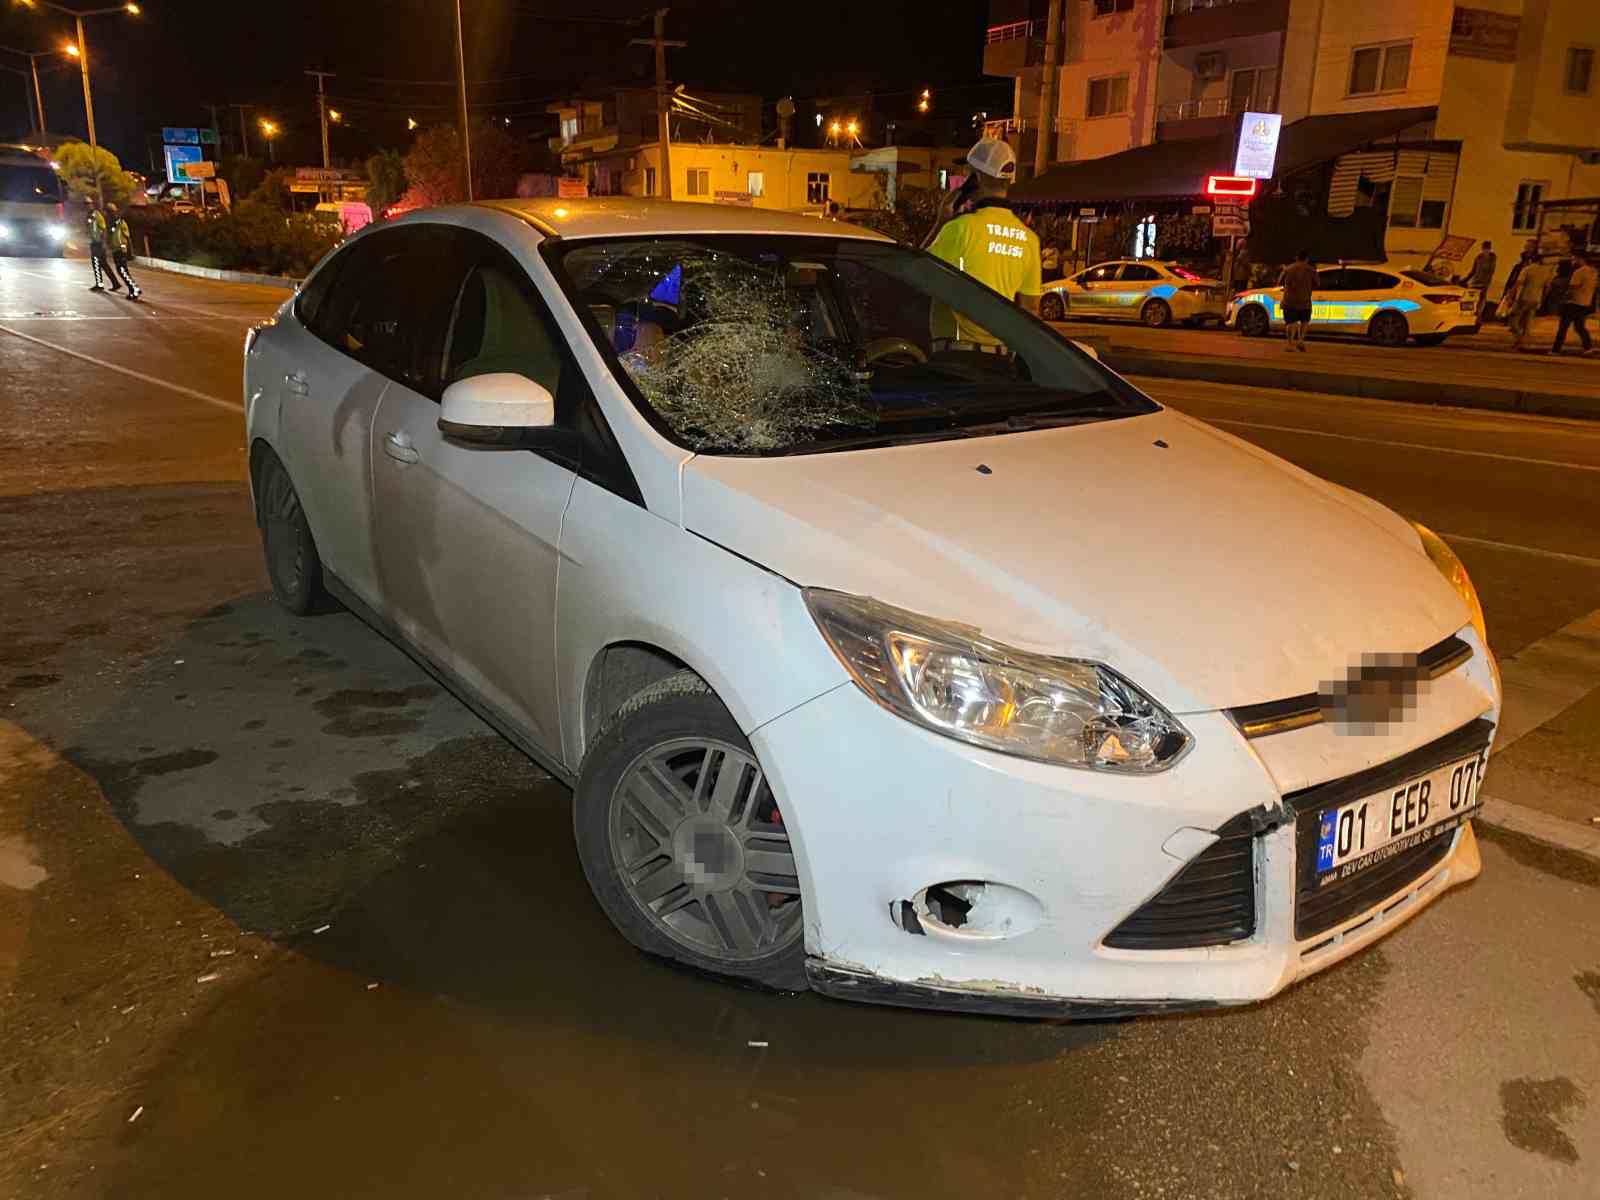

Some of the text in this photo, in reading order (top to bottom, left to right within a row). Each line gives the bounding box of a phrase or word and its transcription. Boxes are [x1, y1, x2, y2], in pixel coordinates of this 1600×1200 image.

[986, 223, 1028, 241] TRAFİK
[988, 241, 1024, 258] POLİSİ
[1337, 802, 1368, 857] 01
[1390, 780, 1431, 837] EEB
[1320, 843, 1333, 858] TR
